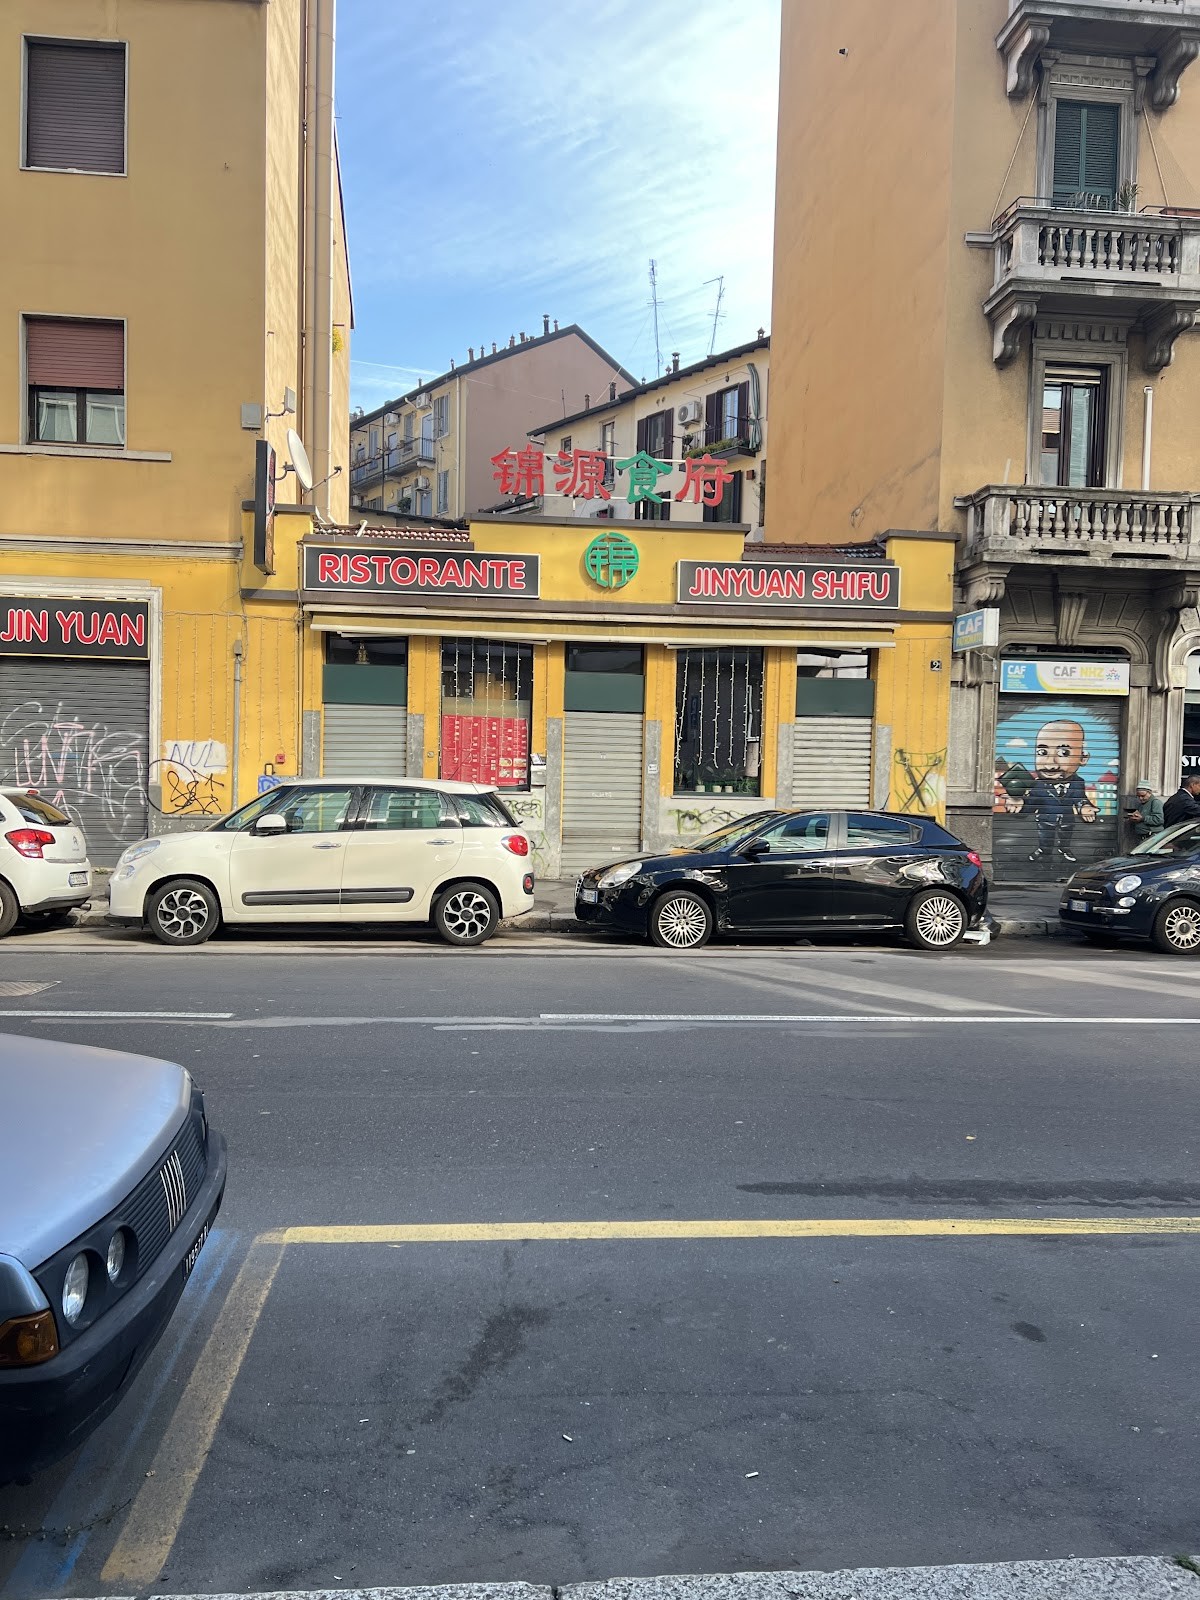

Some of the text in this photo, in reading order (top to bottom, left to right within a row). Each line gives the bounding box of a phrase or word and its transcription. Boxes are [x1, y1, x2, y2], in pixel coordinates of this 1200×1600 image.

[490, 443, 734, 508] 锦源食府
[318, 553, 526, 590] RISTORANTE
[689, 567, 890, 601] JINYUAN SHIFU
[0, 608, 145, 646] JIN YUAN
[956, 615, 983, 637] CAF
[932, 660, 940, 671] 2
[1007, 664, 1027, 675] CAF
[1053, 665, 1105, 678] CAF NHZ
[1181, 755, 1200, 767] ST
